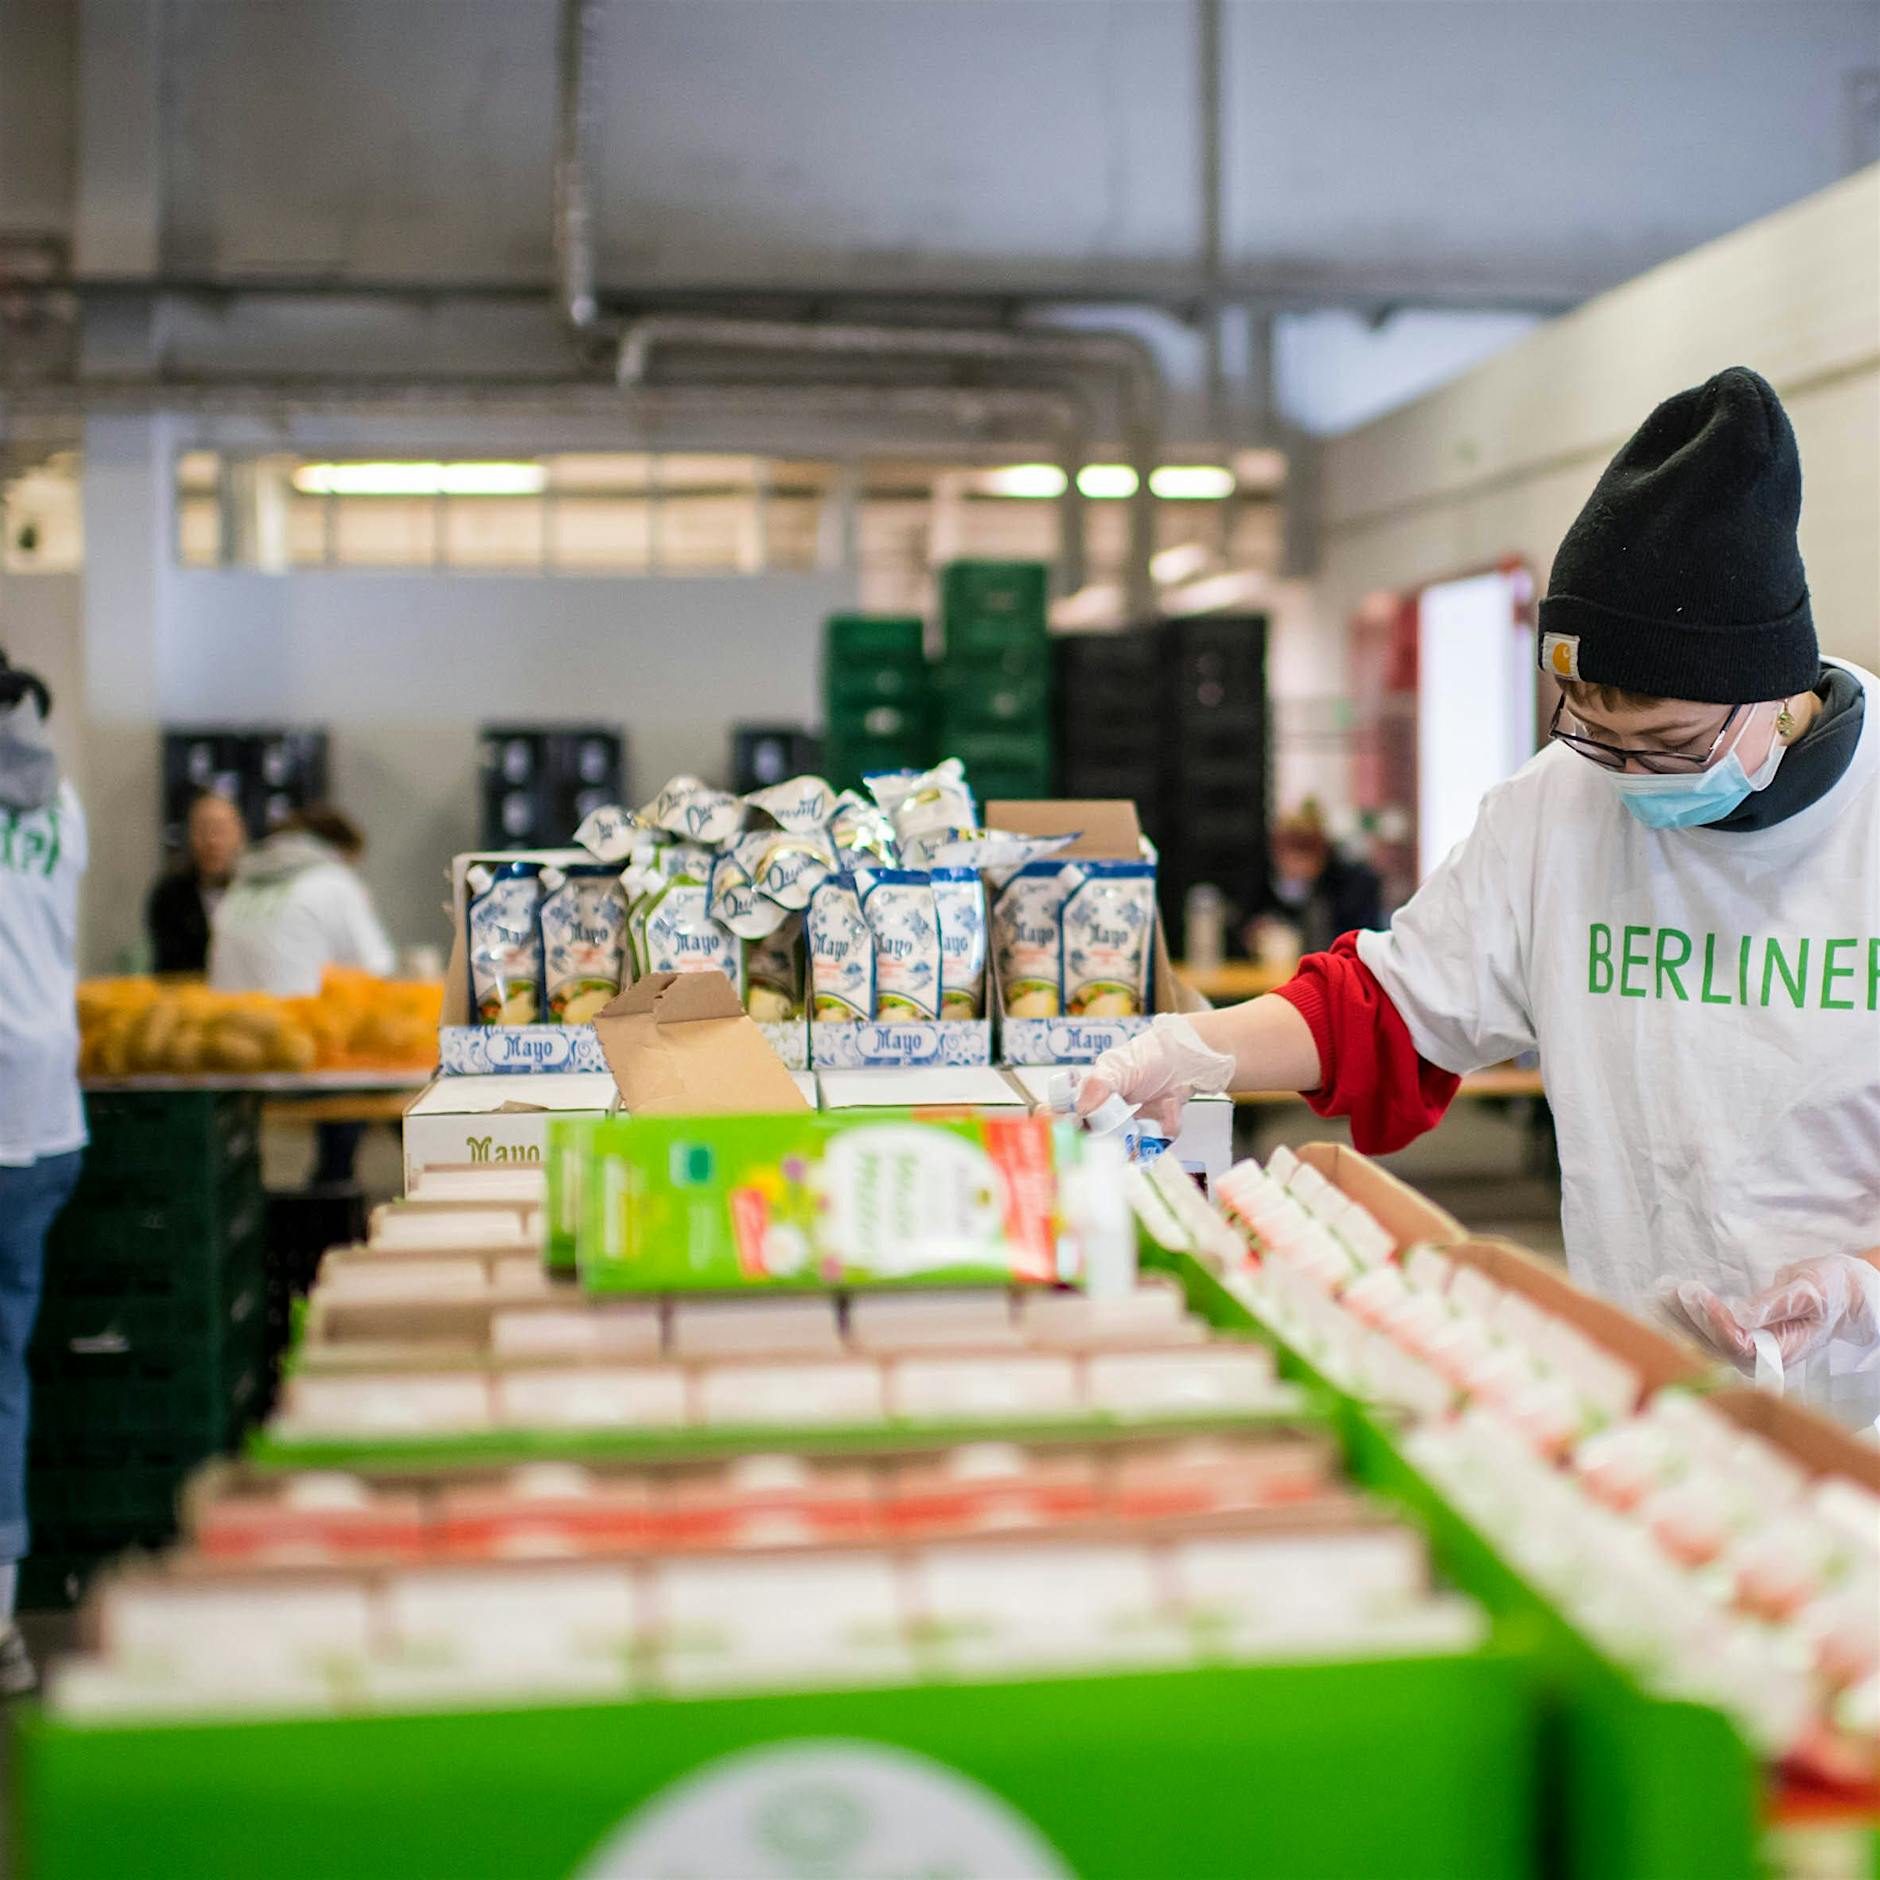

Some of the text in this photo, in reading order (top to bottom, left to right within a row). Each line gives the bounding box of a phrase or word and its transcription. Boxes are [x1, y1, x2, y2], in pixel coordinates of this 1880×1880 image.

[674, 930, 719, 956] Mayo
[814, 931, 849, 962] Mayo
[944, 936, 968, 957] ayo
[503, 1035, 553, 1063] Mayo
[873, 1027, 922, 1055] Mayo
[1065, 1027, 1113, 1054] Mayo
